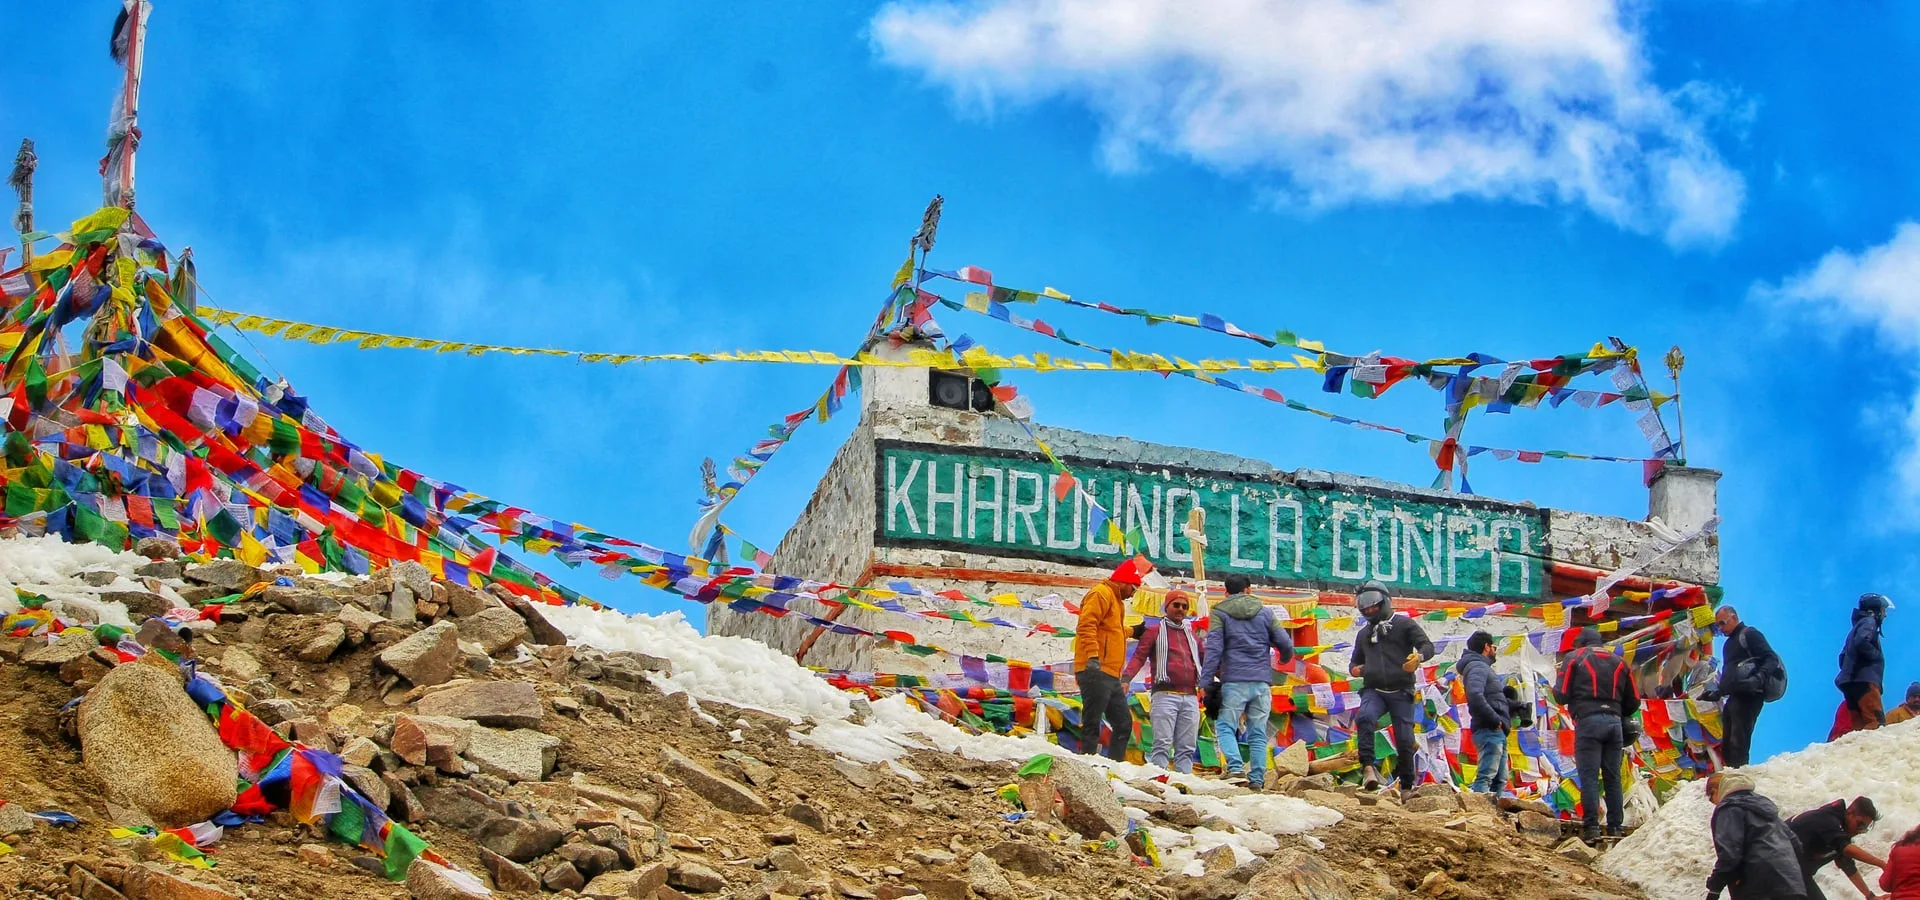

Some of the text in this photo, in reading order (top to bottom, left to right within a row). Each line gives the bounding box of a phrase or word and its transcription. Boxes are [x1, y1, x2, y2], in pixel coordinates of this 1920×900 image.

[886, 455, 1530, 594] KHARDUNG LA GONPA
